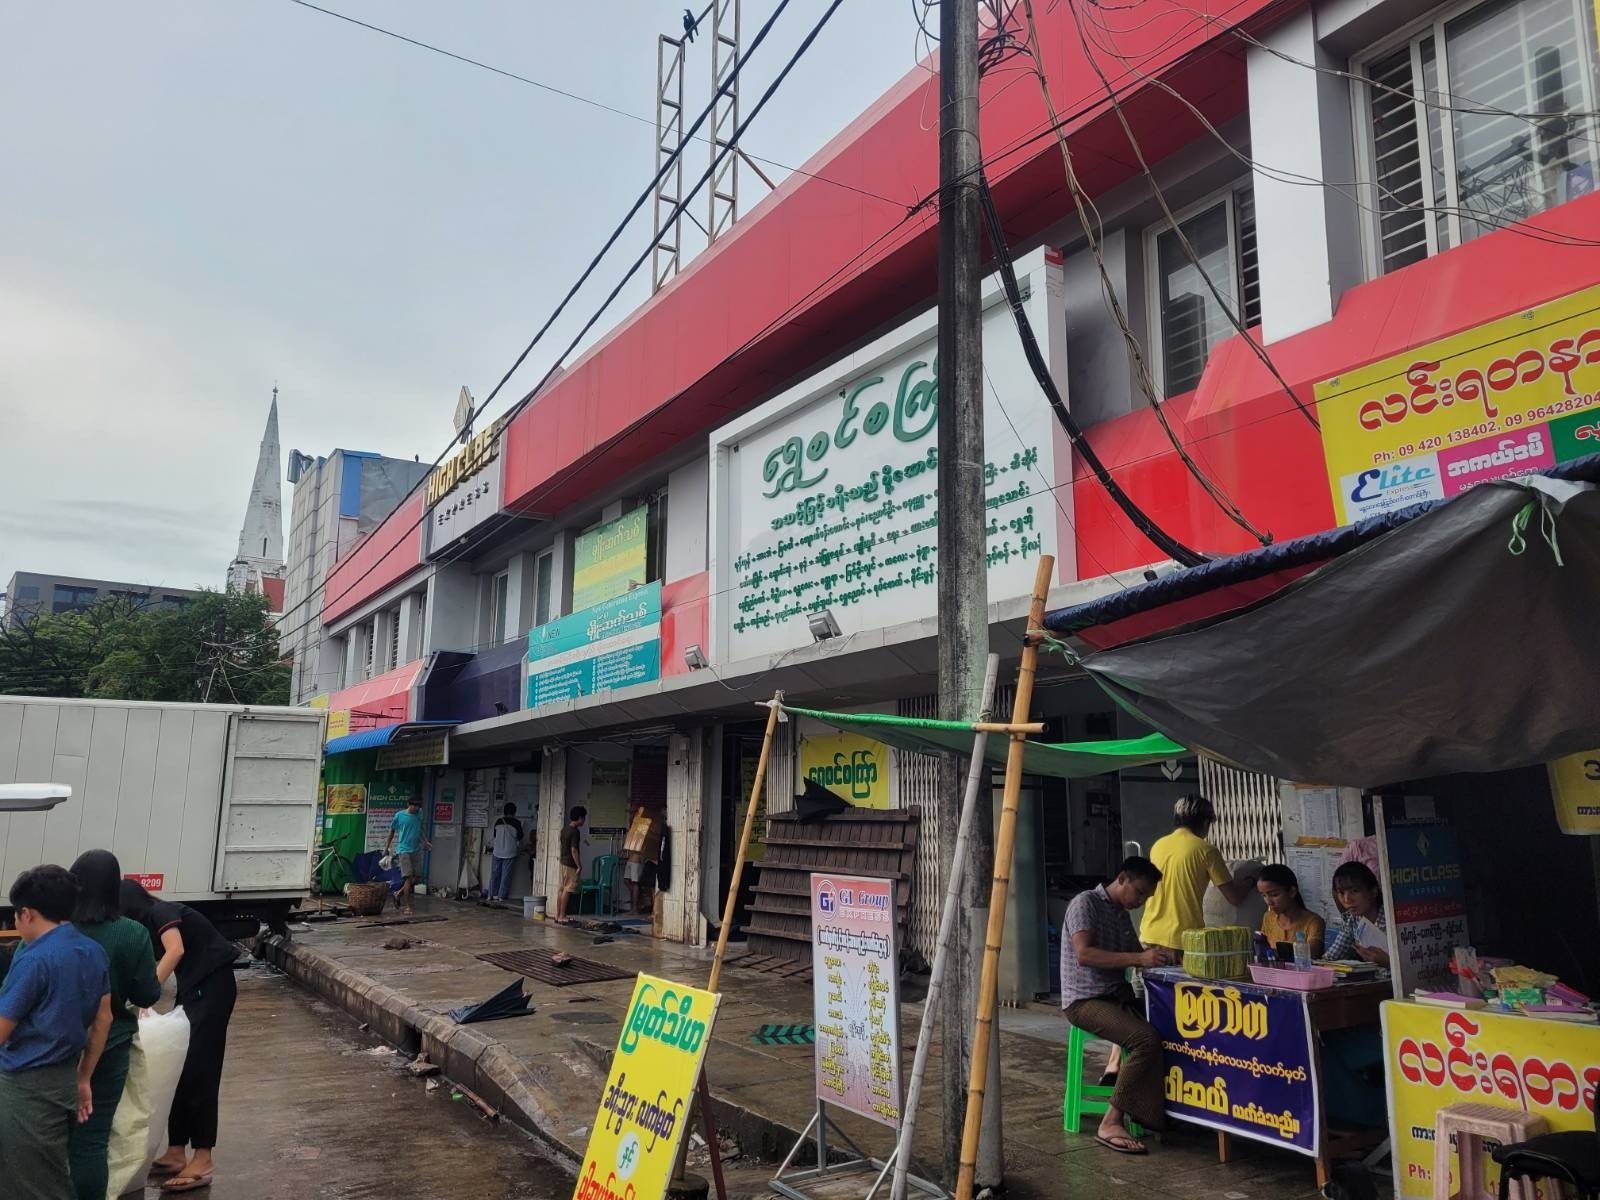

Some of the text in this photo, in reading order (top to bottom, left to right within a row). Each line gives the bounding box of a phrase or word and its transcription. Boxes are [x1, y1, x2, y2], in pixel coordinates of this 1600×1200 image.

[1373, 451, 1396, 464] Ph:
[1398, 444, 1415, 457] 09
[1418, 436, 1442, 451] 420
[1447, 420, 1501, 444] 138402,
[1505, 413, 1523, 427] 09
[1350, 463, 1437, 503] Elite
[858, 891, 889, 911] Group
[1408, 1163, 1432, 1181] Ph:
